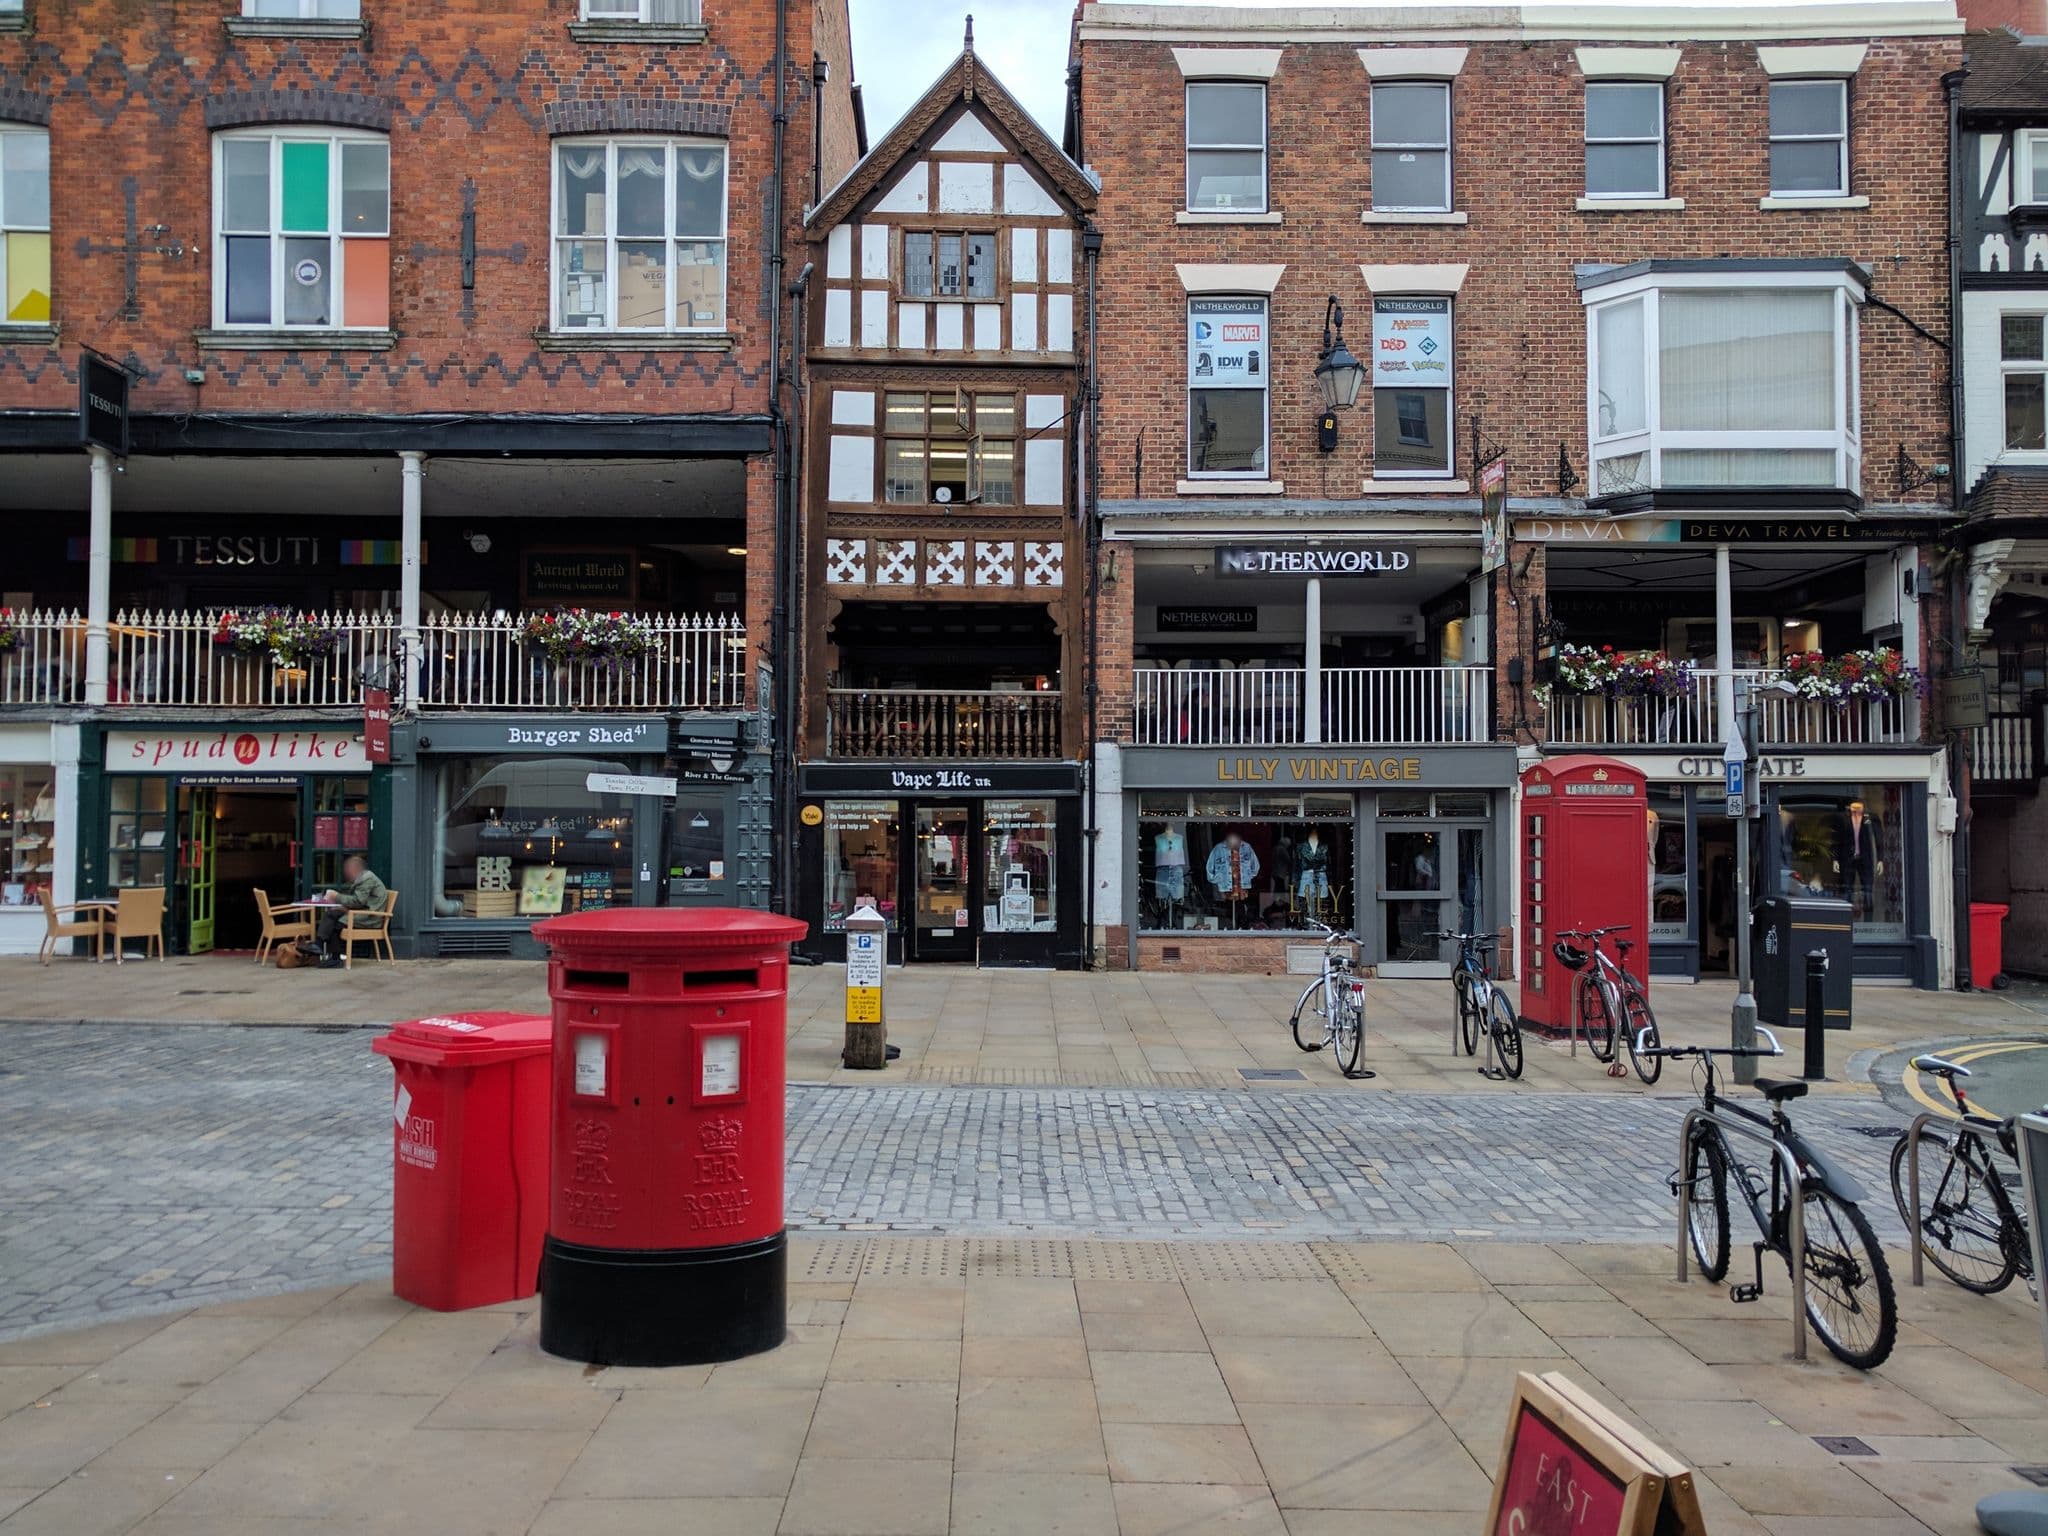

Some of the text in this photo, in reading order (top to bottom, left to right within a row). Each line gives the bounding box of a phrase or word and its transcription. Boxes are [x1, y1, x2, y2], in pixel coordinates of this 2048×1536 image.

[1195, 303, 1259, 311] NETHERWORLD
[1378, 302, 1443, 310] NETHERWORLD
[1223, 325, 1260, 342] MARVEL
[1217, 356, 1244, 367] IDW
[88, 392, 122, 419] TESSUTI
[1531, 521, 1626, 540] DEVA
[1689, 524, 1752, 538] DEVA
[1762, 524, 1851, 538] TRAVEL
[168, 535, 320, 565] TESSUTI
[534, 559, 625, 577] Ancient World
[1222, 551, 1410, 573] NETHERWORLD
[1161, 612, 1254, 624] NETHERWORLD
[507, 727, 581, 746] Burger
[1217, 756, 1422, 781] LILY VINTAGE
[1730, 764, 1741, 792] P
[891, 770, 933, 790] Vape
[935, 770, 972, 788] Life
[484, 818, 537, 833] Burger
[1288, 884, 1346, 914] LILY
[860, 936, 870, 948] P
[563, 1187, 622, 1211] ROYAL
[683, 1188, 752, 1212] ROYAL
[689, 1207, 747, 1231] MAIL
[1535, 1452, 1593, 1525] EAST
